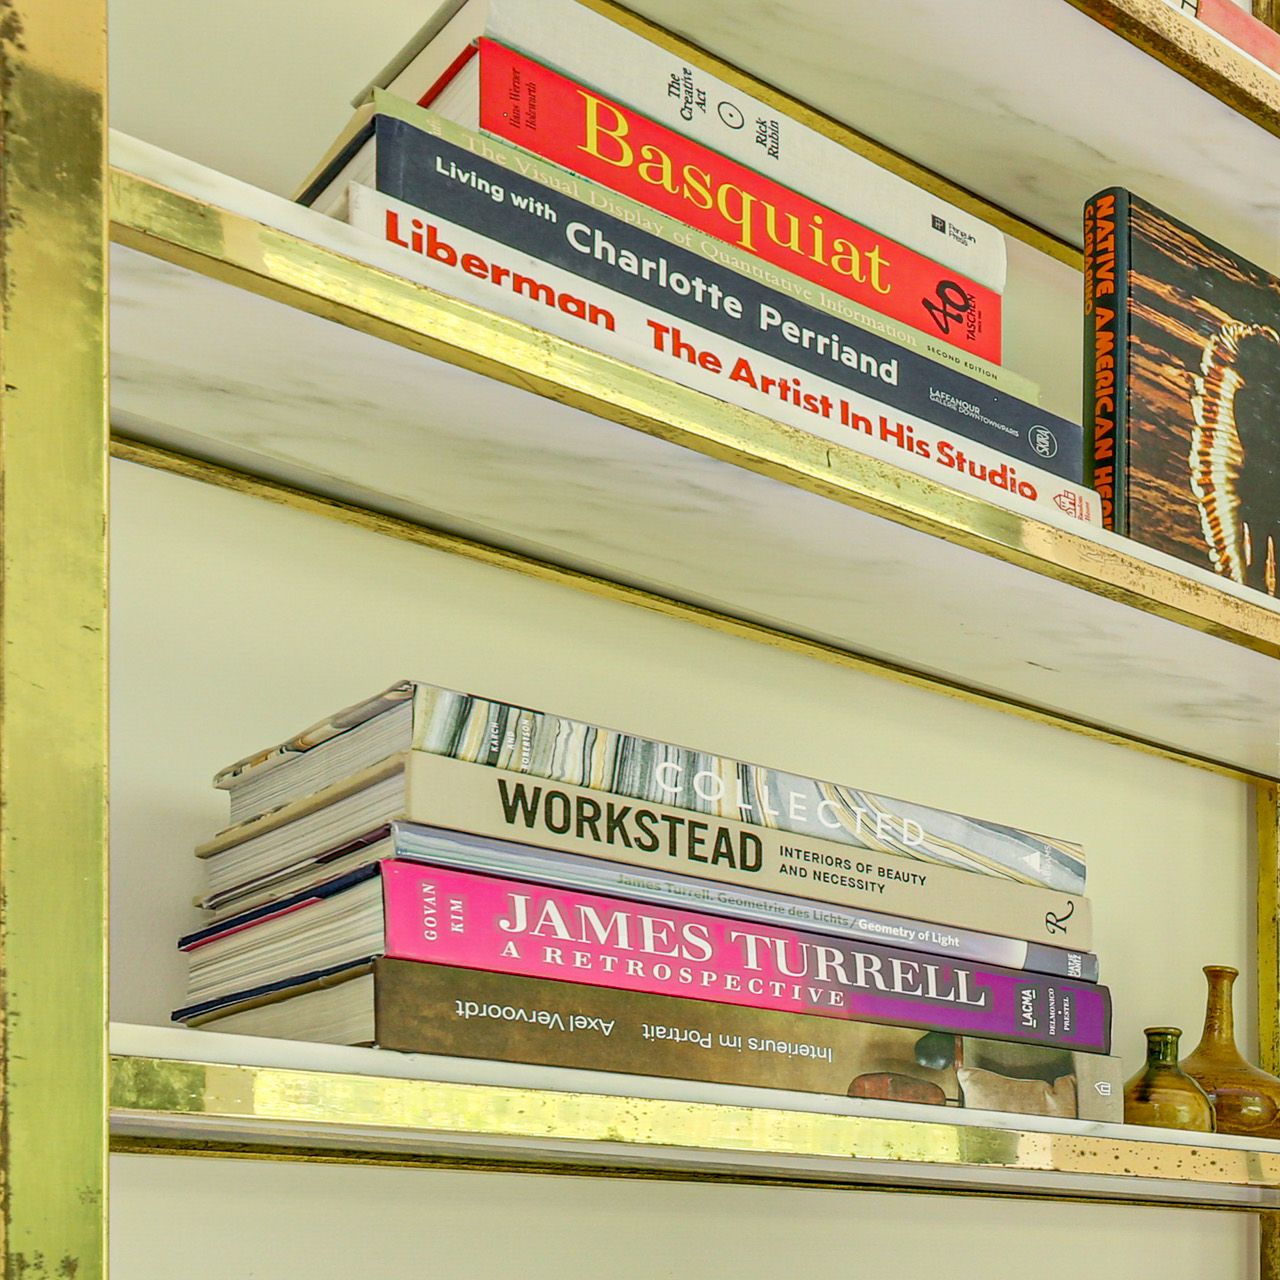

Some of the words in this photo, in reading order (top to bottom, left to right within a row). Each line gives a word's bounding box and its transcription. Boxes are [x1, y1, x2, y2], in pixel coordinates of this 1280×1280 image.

[668, 73, 681, 99] The
[680, 67, 693, 121] Creative
[695, 89, 707, 113] Act
[756, 117, 768, 147] Rick
[768, 120, 780, 160] Rubin
[577, 89, 891, 295] Basquiat
[515, 157, 579, 196] Visual
[590, 191, 664, 235] Display
[673, 230, 694, 248] of
[820, 292, 917, 347] Information
[1096, 194, 1116, 298] NATIVE
[436, 156, 505, 202] Living
[511, 190, 558, 223] with
[565, 221, 744, 319] Charlotte
[759, 303, 899, 387] Perriand
[385, 208, 616, 333] Liberman
[647, 319, 723, 374] The
[728, 357, 834, 419] Artist
[840, 394, 873, 436] In
[879, 415, 931, 459] His
[936, 440, 1039, 502] Studio
[926, 345, 961, 365] SECOND
[964, 361, 999, 380] EDITION
[1093, 306, 1116, 461] AMERICAN
[655, 761, 925, 847] COLLECTED
[497, 778, 764, 873] WORKSTEAD
[779, 845, 853, 873] INTERIORS
[856, 860, 873, 875] OF
[877, 864, 927, 887] BEAUTY
[779, 863, 808, 881] AND
[813, 869, 886, 895] NECESSITY
[425, 882, 437, 941] GOVAN
[451, 898, 464, 934] KIM
[499, 893, 713, 962] JAMES
[730, 930, 986, 1007] TURRELL
[858, 919, 917, 940] Geometry
[918, 928, 931, 941] of
[932, 932, 961, 948] Light
[501, 941, 521, 959] A
[543, 948, 845, 1007] RETROSPECTIVE
[455, 1000, 565, 1032] Vervoordt
[569, 1013, 615, 1038] Axel
[1021, 989, 1036, 1028] LACMA
[642, 1023, 713, 1049] Portrait
[719, 1034, 743, 1050] im
[746, 1035, 833, 1064] Interieurs
